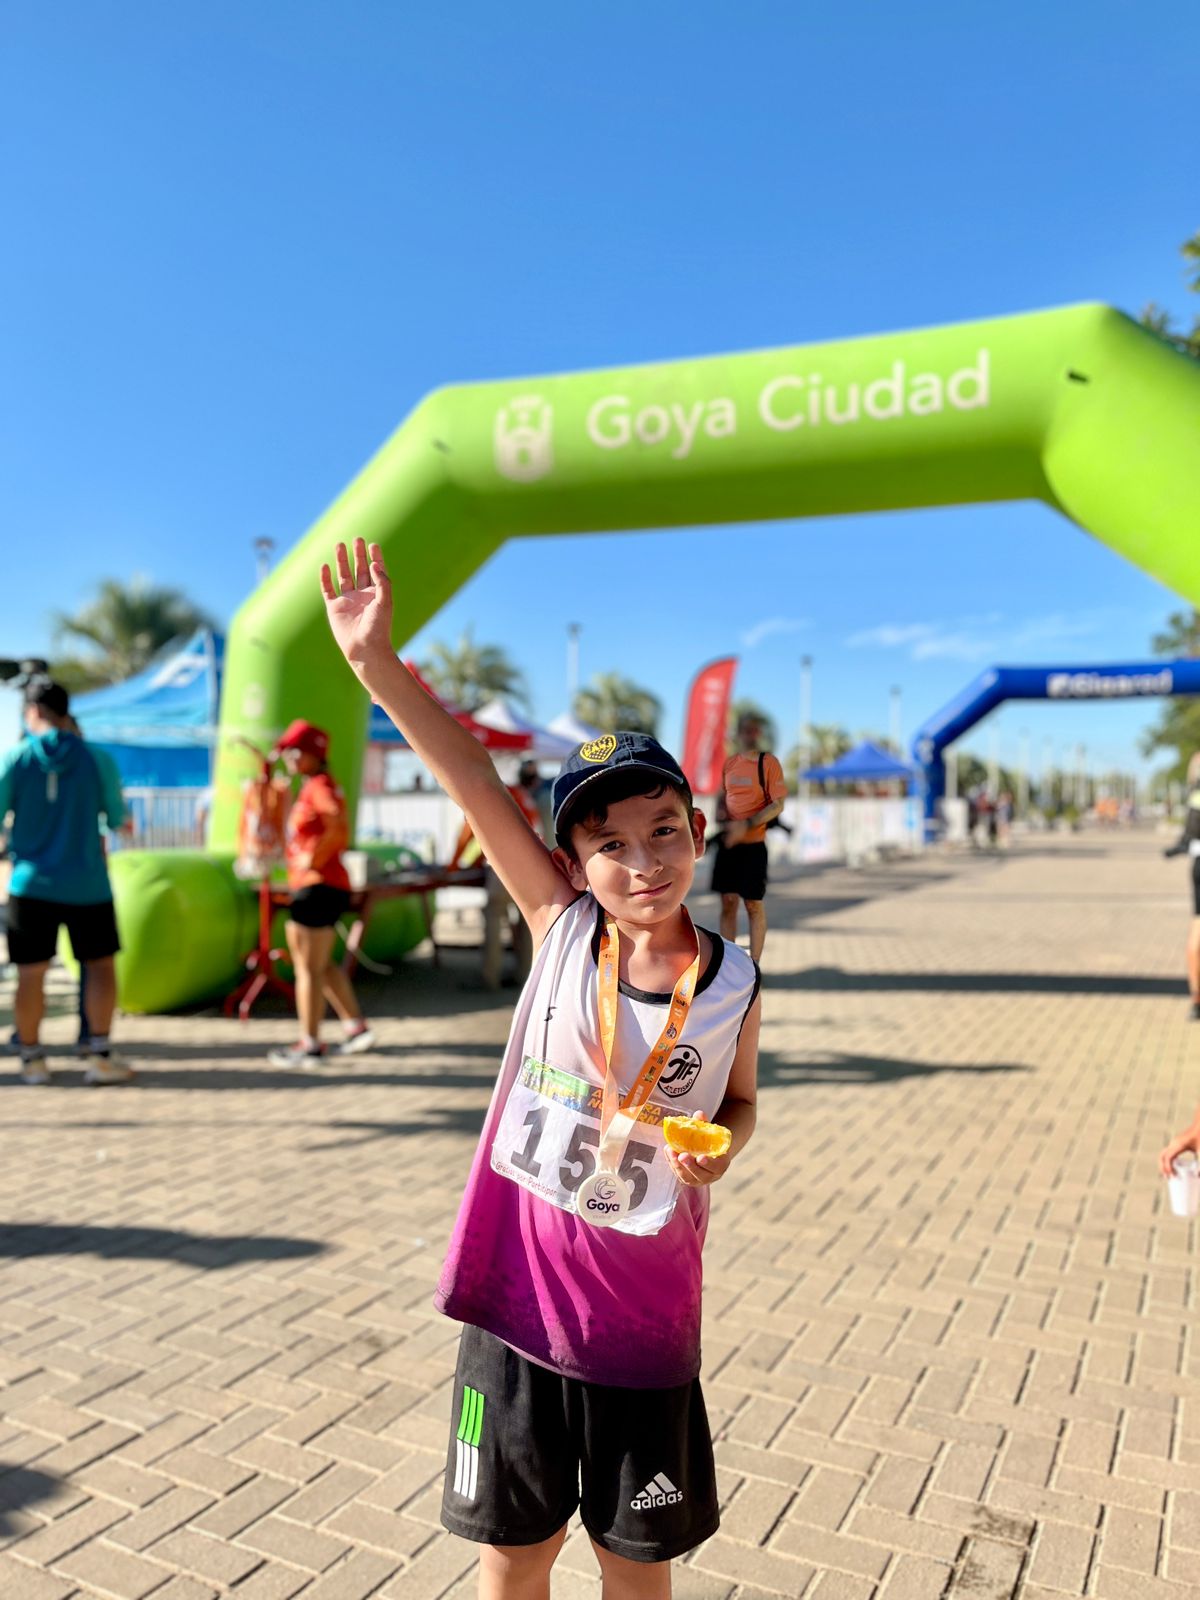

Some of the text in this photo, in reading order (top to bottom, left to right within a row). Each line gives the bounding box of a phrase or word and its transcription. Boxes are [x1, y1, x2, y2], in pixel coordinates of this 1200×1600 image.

[586, 347, 992, 460] Goya Ciudad
[664, 1079, 693, 1094] ATLETISMO
[586, 1198, 620, 1214] Goya
[630, 1490, 683, 1510] adidas
